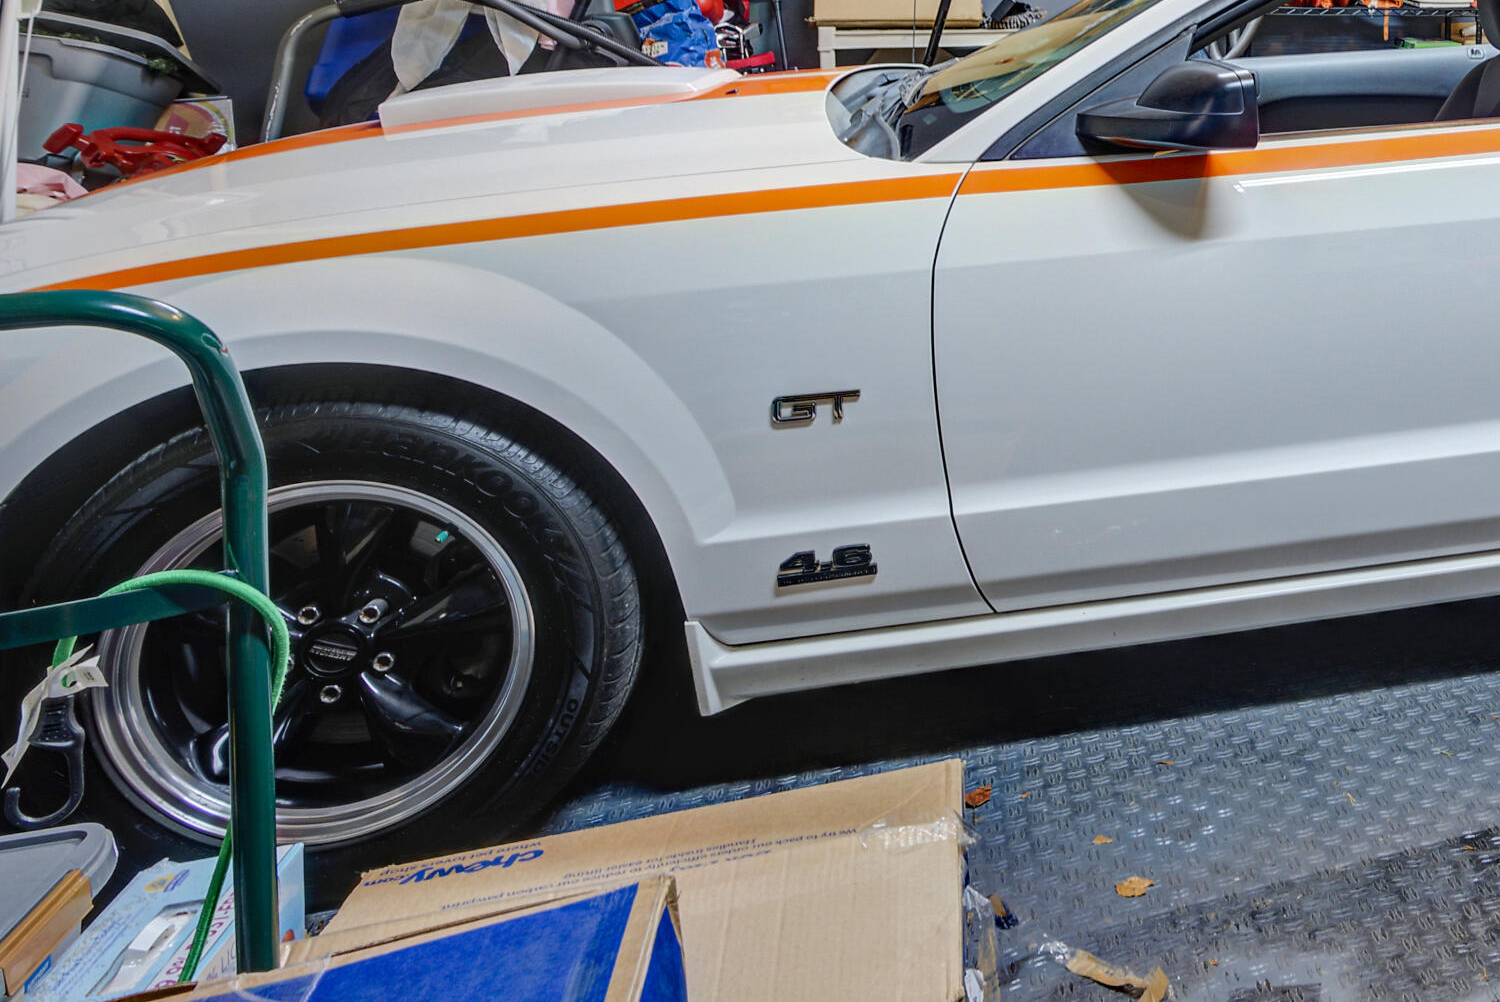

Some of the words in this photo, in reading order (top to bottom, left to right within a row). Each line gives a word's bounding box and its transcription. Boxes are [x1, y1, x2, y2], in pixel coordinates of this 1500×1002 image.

[771, 389, 861, 425] GT
[777, 542, 874, 574] 4.6
[364, 849, 545, 886] chewy.com
[468, 849, 493, 859] pet
